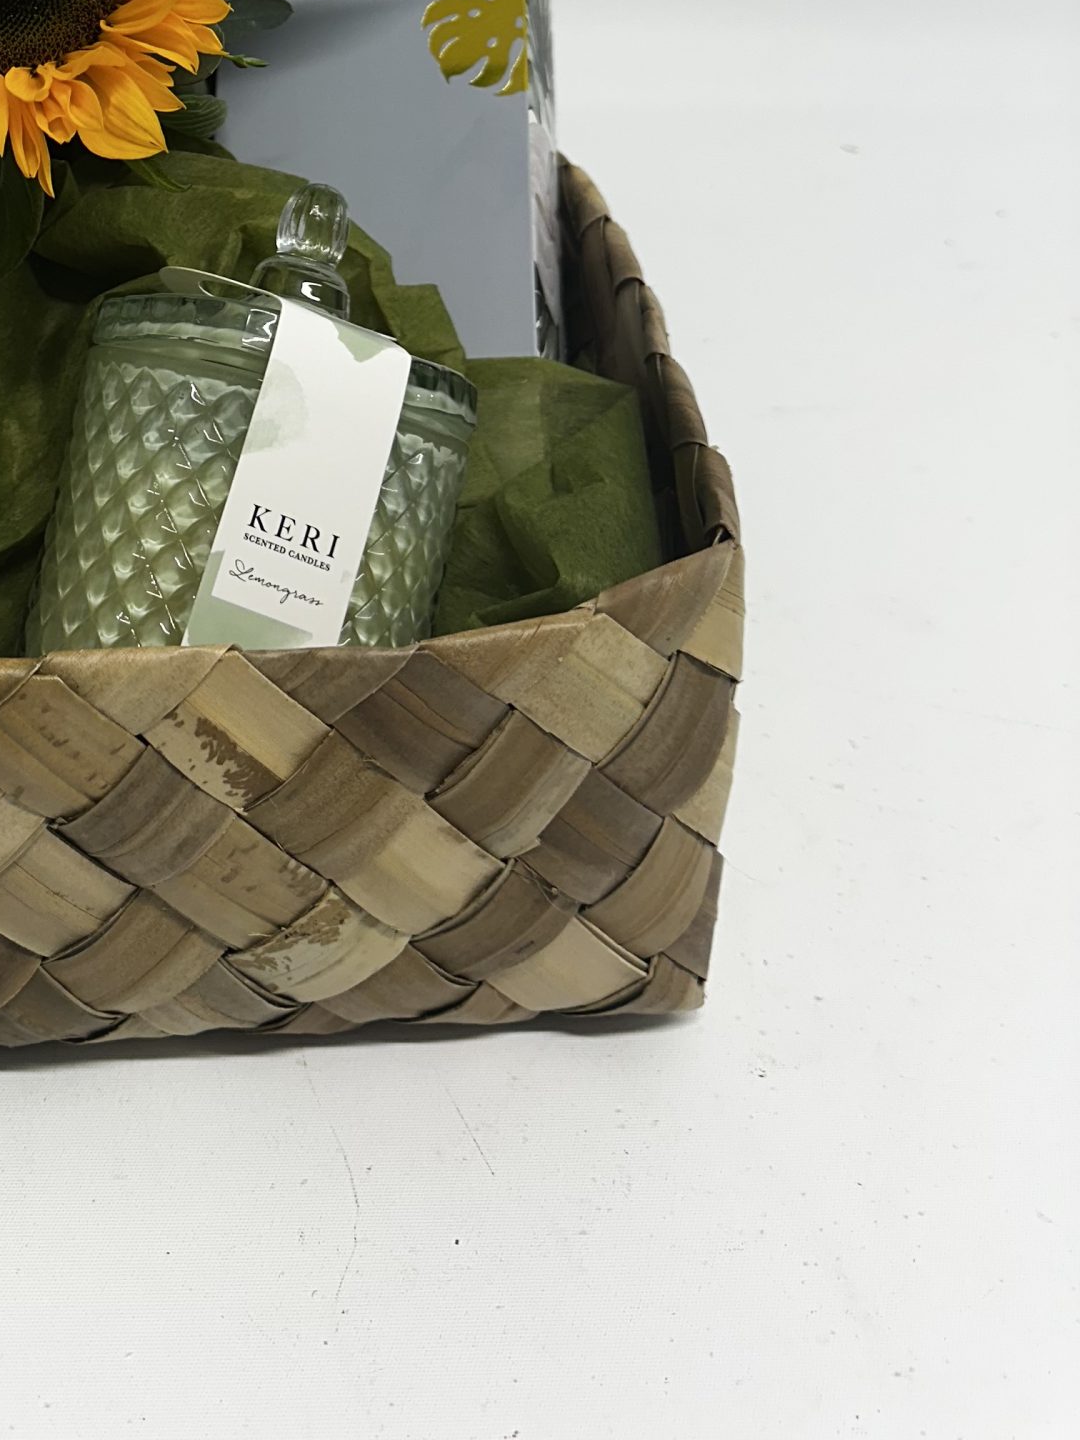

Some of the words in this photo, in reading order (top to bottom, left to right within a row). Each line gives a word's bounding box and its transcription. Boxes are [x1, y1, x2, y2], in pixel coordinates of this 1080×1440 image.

[243, 532, 287, 555] SCENTED
[288, 549, 331, 572] CANDLES
[247, 504, 340, 559] KERI
[228, 559, 324, 606] Lemongrass
